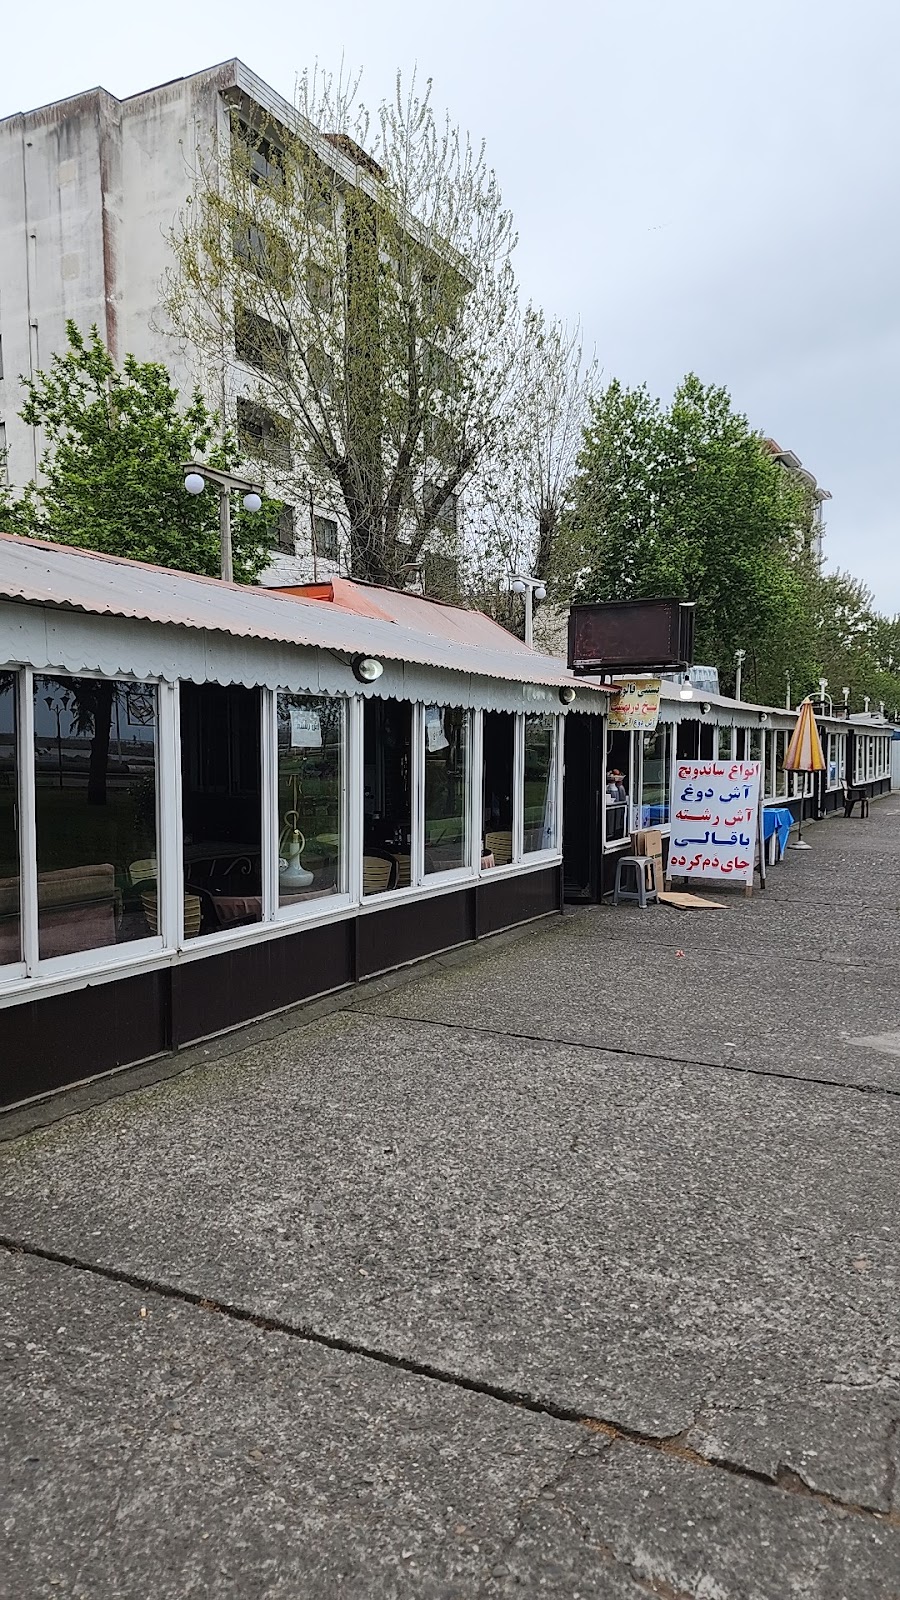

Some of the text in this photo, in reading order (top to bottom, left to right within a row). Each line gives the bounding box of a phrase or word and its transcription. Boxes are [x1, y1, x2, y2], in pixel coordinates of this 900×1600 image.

[678, 762, 760, 780] انواع ساندویچ
[680, 783, 753, 802] آش دوغ
[675, 808, 754, 826] آش رشته
[674, 831, 750, 850] باقالی
[720, 856, 750, 875] چای
